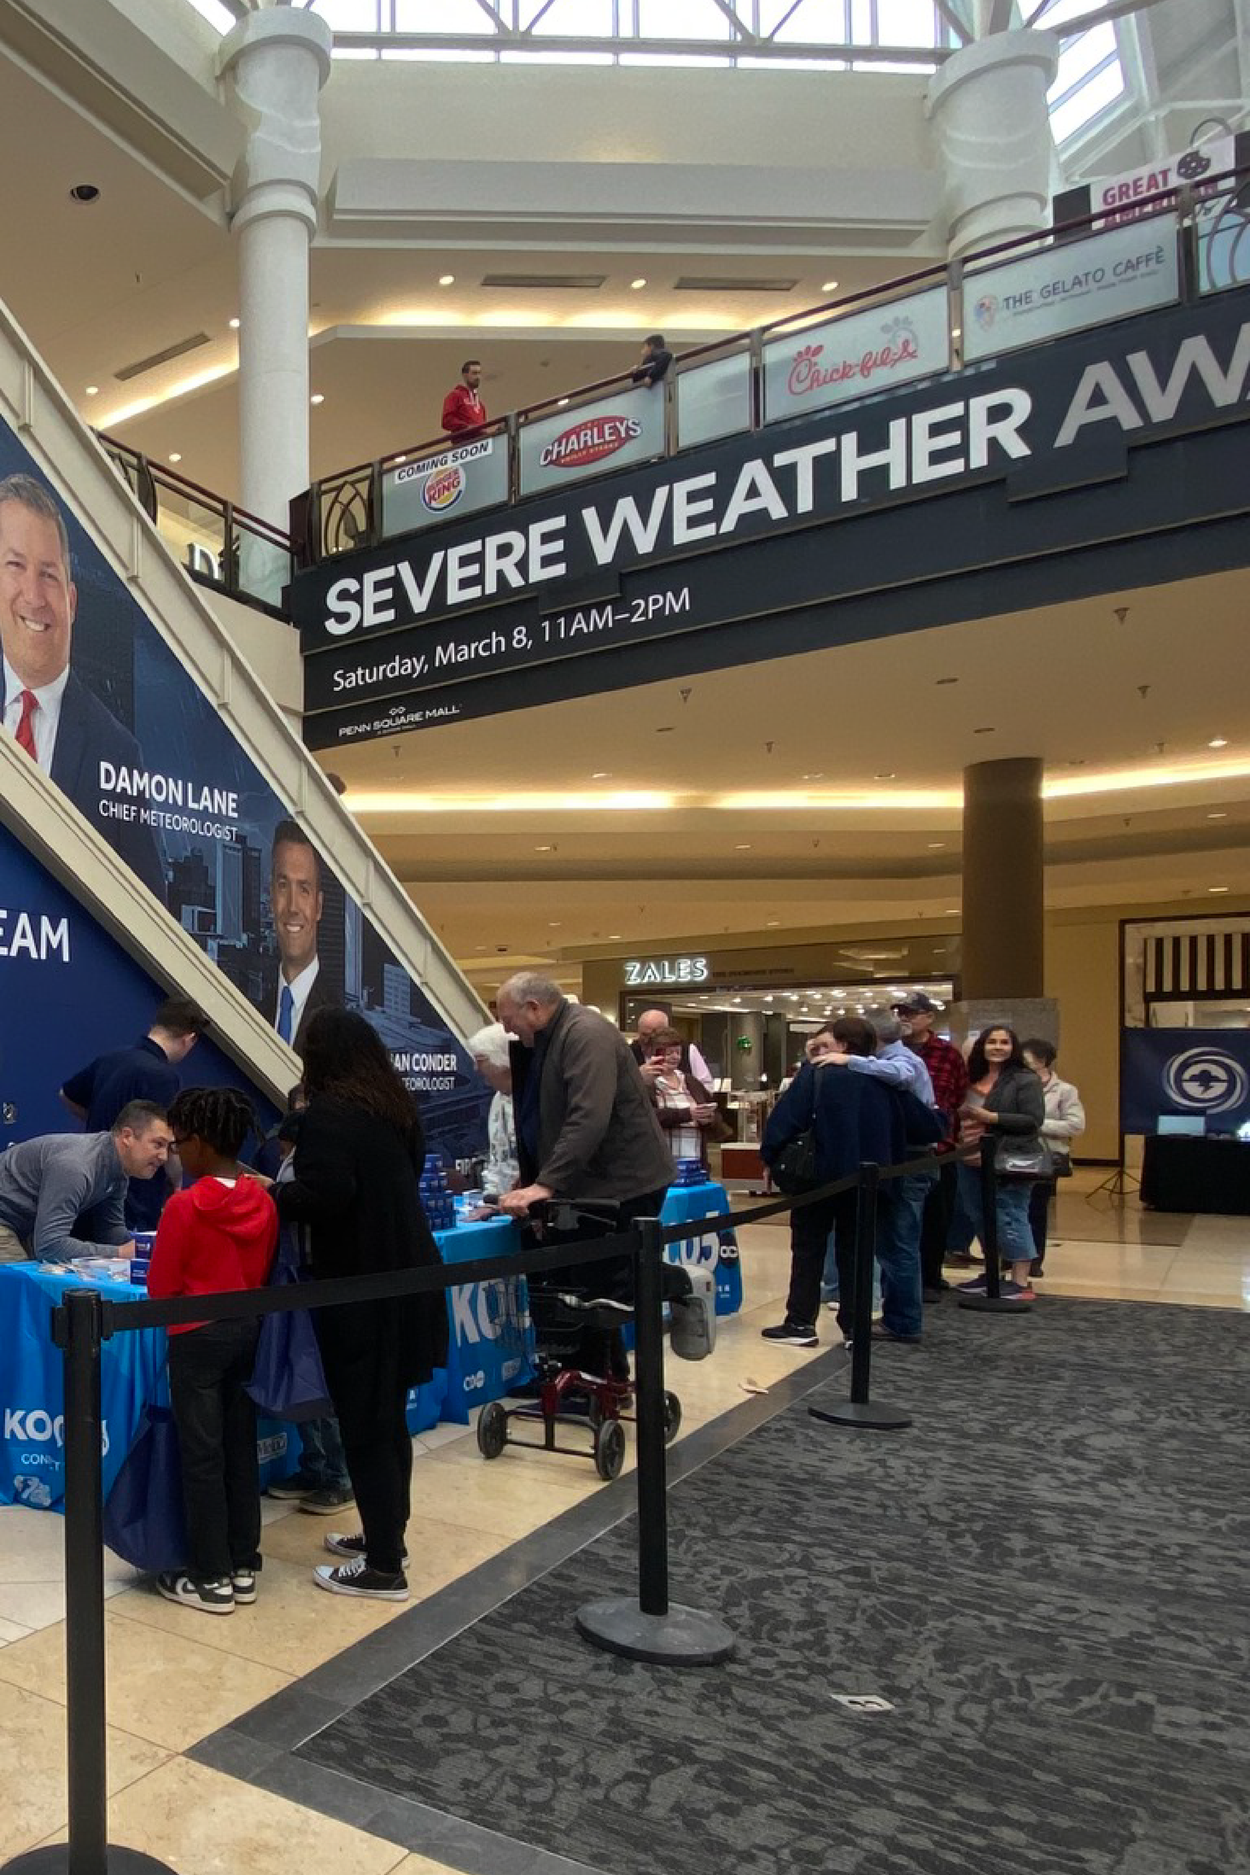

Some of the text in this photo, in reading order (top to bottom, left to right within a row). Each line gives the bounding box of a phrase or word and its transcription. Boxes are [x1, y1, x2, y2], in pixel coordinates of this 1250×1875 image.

[1102, 168, 1172, 206] GREAT
[1003, 290, 1033, 310] THE
[1039, 268, 1105, 299] GELATO
[788, 339, 918, 395] Chick-fil-A
[397, 441, 489, 481] COMING SOON
[539, 419, 642, 466] CHARLEYS
[324, 322, 1250, 637] SEVERE WEATHER AW
[427, 478, 460, 504] KING
[333, 652, 429, 692] Saturday,
[435, 631, 506, 667] March
[512, 626, 533, 650] 8,
[338, 723, 371, 737] PENN
[373, 711, 424, 731] SQUARE
[425, 705, 460, 719] MALL
[99, 761, 239, 818] DAMON LANE
[98, 800, 238, 842] CHIEF METEOROLOGIST
[625, 957, 709, 985] ZALES
[411, 1053, 457, 1072] CONDER
